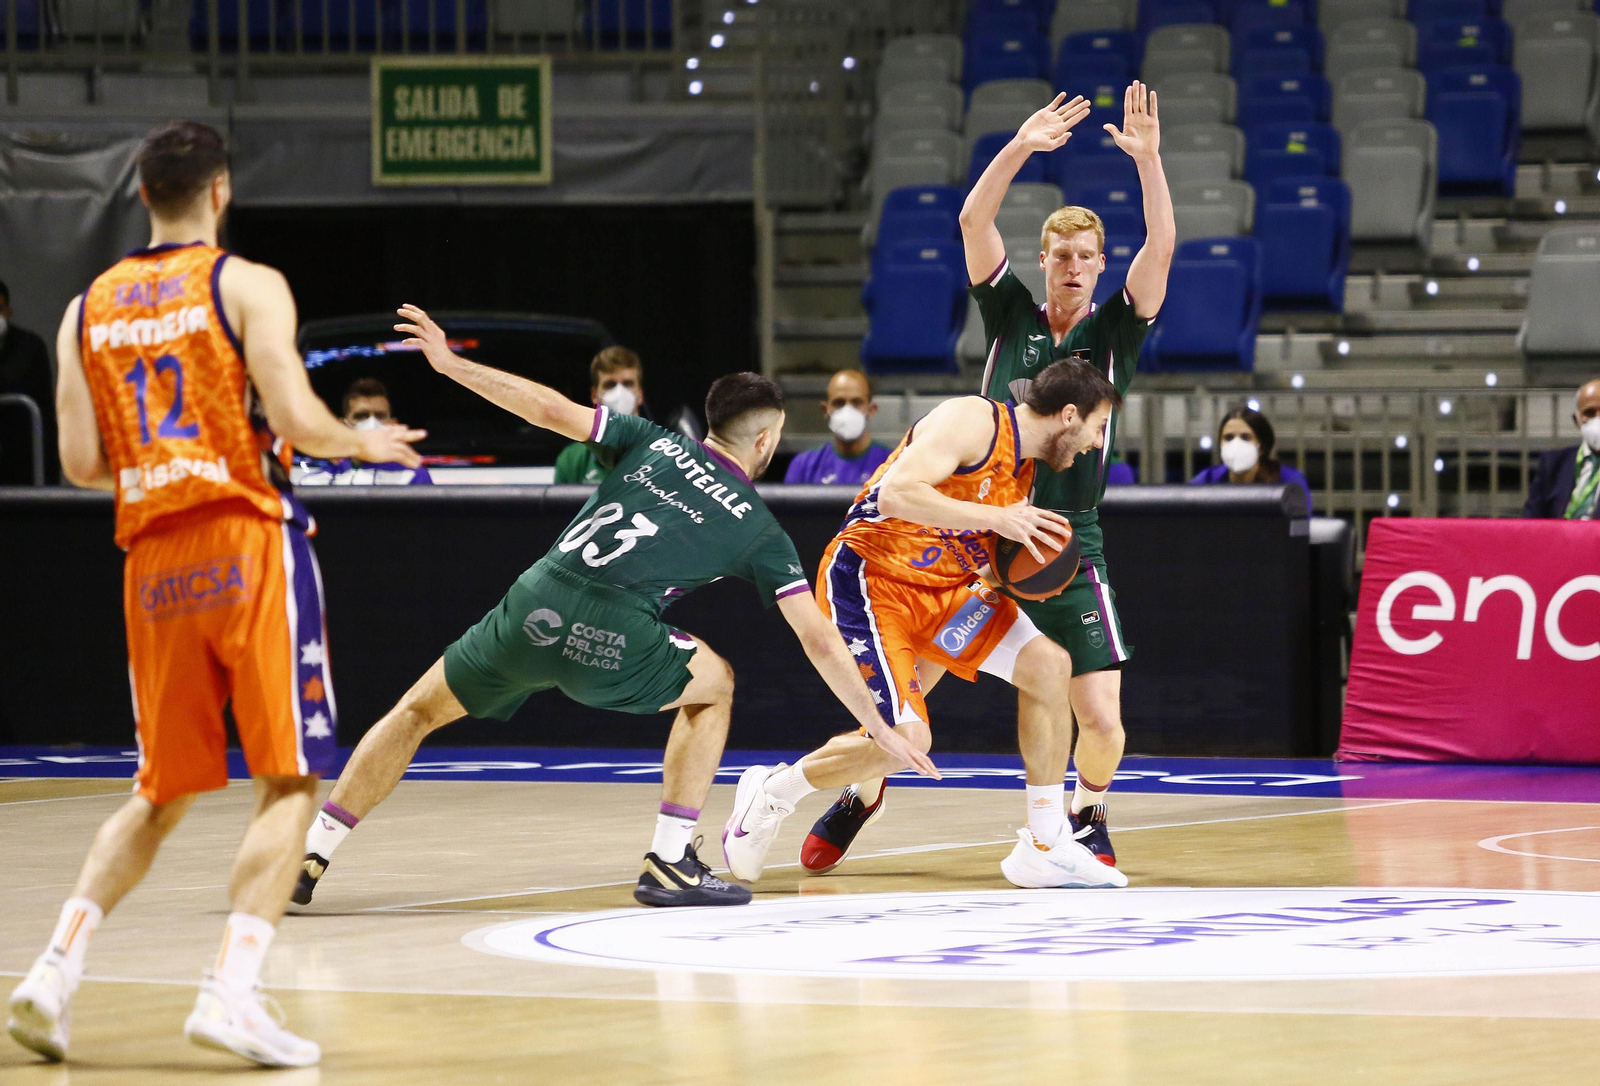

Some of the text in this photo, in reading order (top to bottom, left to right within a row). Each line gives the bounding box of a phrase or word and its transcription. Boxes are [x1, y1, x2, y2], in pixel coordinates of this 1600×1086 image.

[394, 84, 527, 121] SALIDA DE
[385, 126, 536, 162] EMERGENCIA
[89, 305, 207, 350] PAMESA
[124, 354, 200, 445] 12
[143, 456, 230, 490] isaval
[649, 437, 752, 520] BOUTEILLE
[558, 502, 659, 568] 83
[910, 546, 942, 568] 9
[571, 622, 626, 648] COSTA
[940, 604, 990, 652] Midea
[562, 646, 620, 671] MÁLAGA
[565, 635, 623, 660] DEL SOL
[843, 897, 1516, 966] PEDRIZAS
